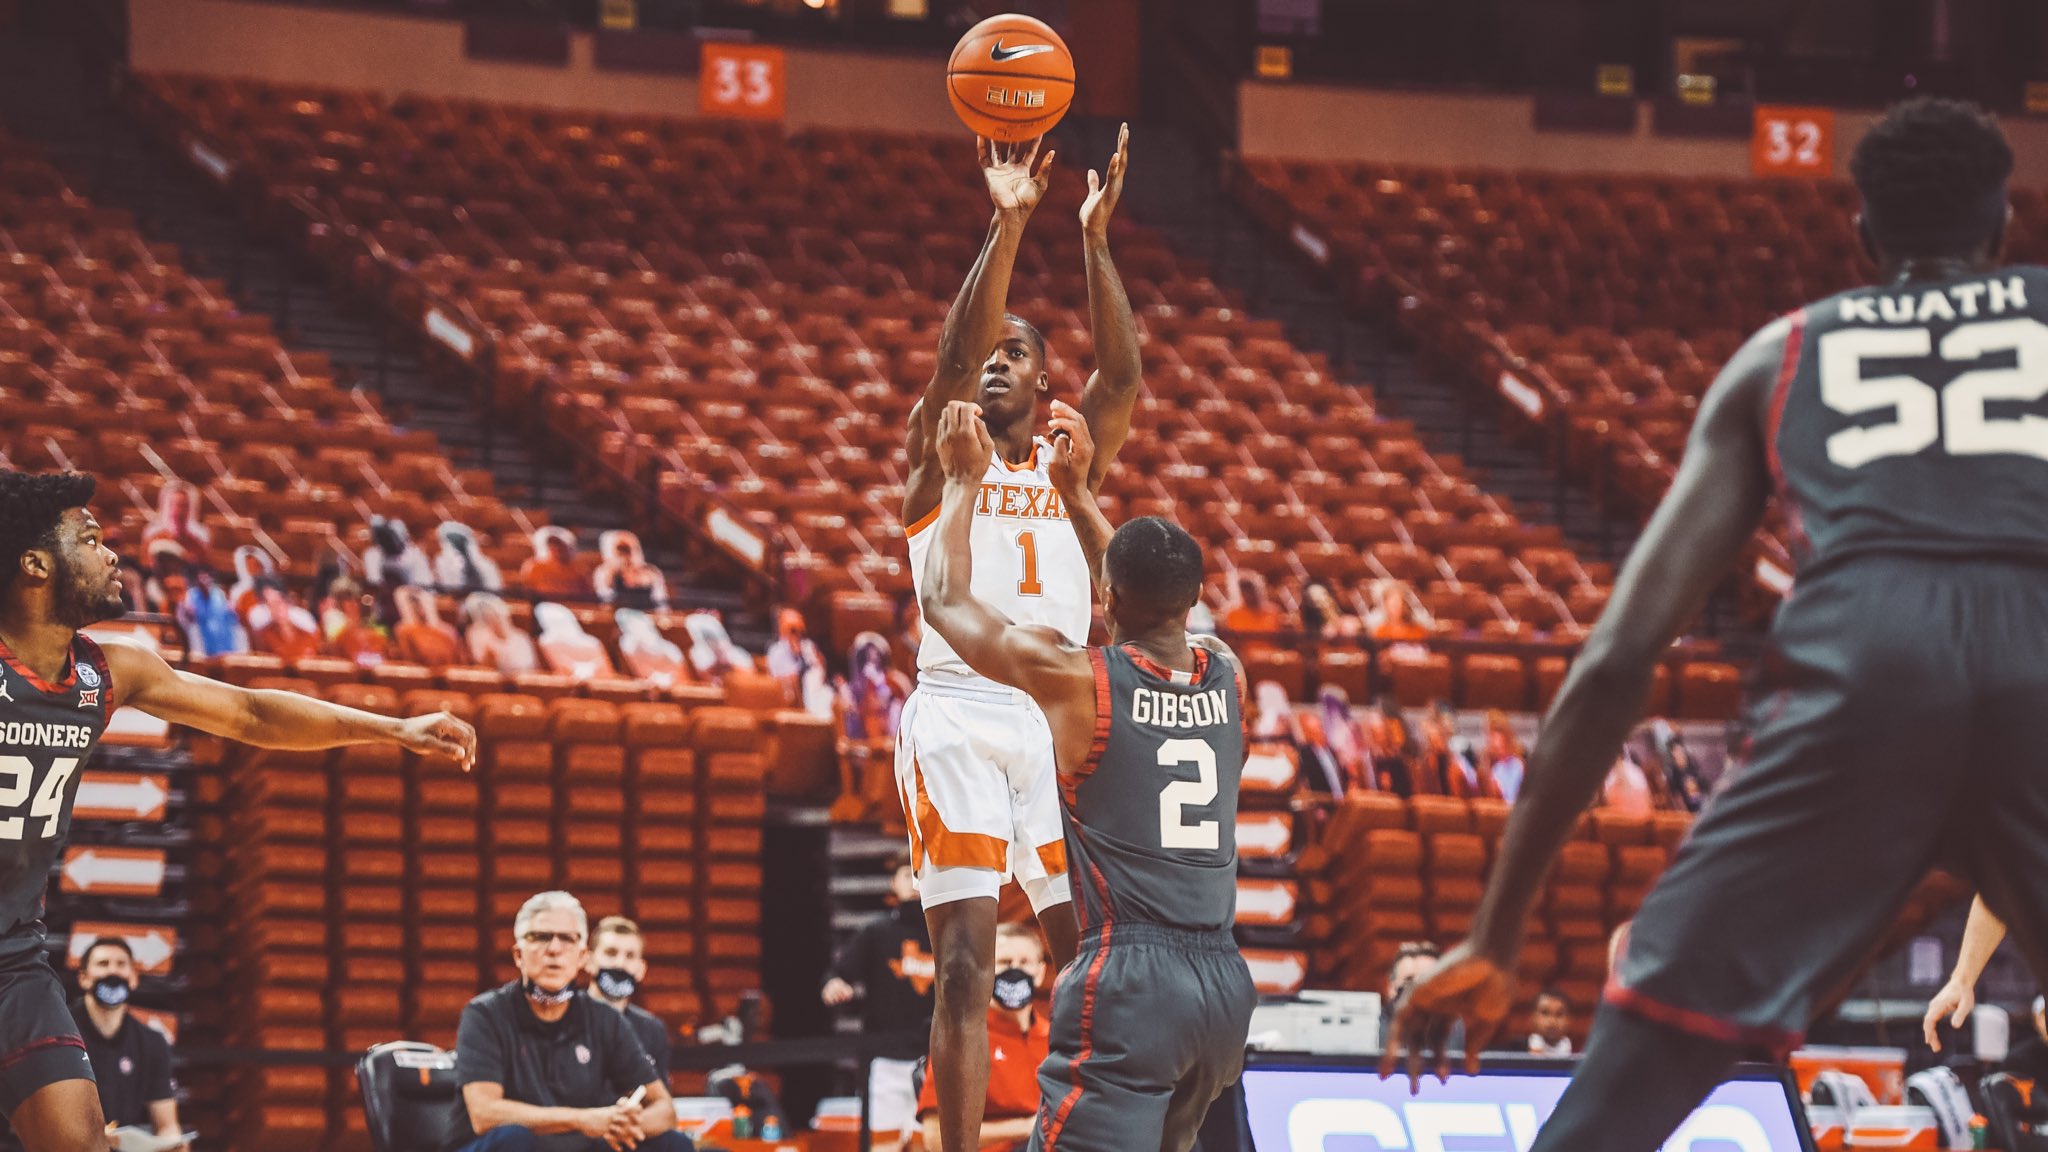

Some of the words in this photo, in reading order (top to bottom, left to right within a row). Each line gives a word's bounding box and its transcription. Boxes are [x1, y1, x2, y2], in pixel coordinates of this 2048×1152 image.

[714, 58, 771, 105] 33
[1766, 121, 1822, 164] 32
[1839, 276, 2027, 322] KUATH
[1818, 318, 2048, 468] 52
[976, 482, 1070, 520] TEXA
[1016, 530, 1043, 597] 1
[1131, 687, 1229, 729] GIBSON
[0, 755, 80, 840] 24
[1157, 738, 1219, 849] 2
